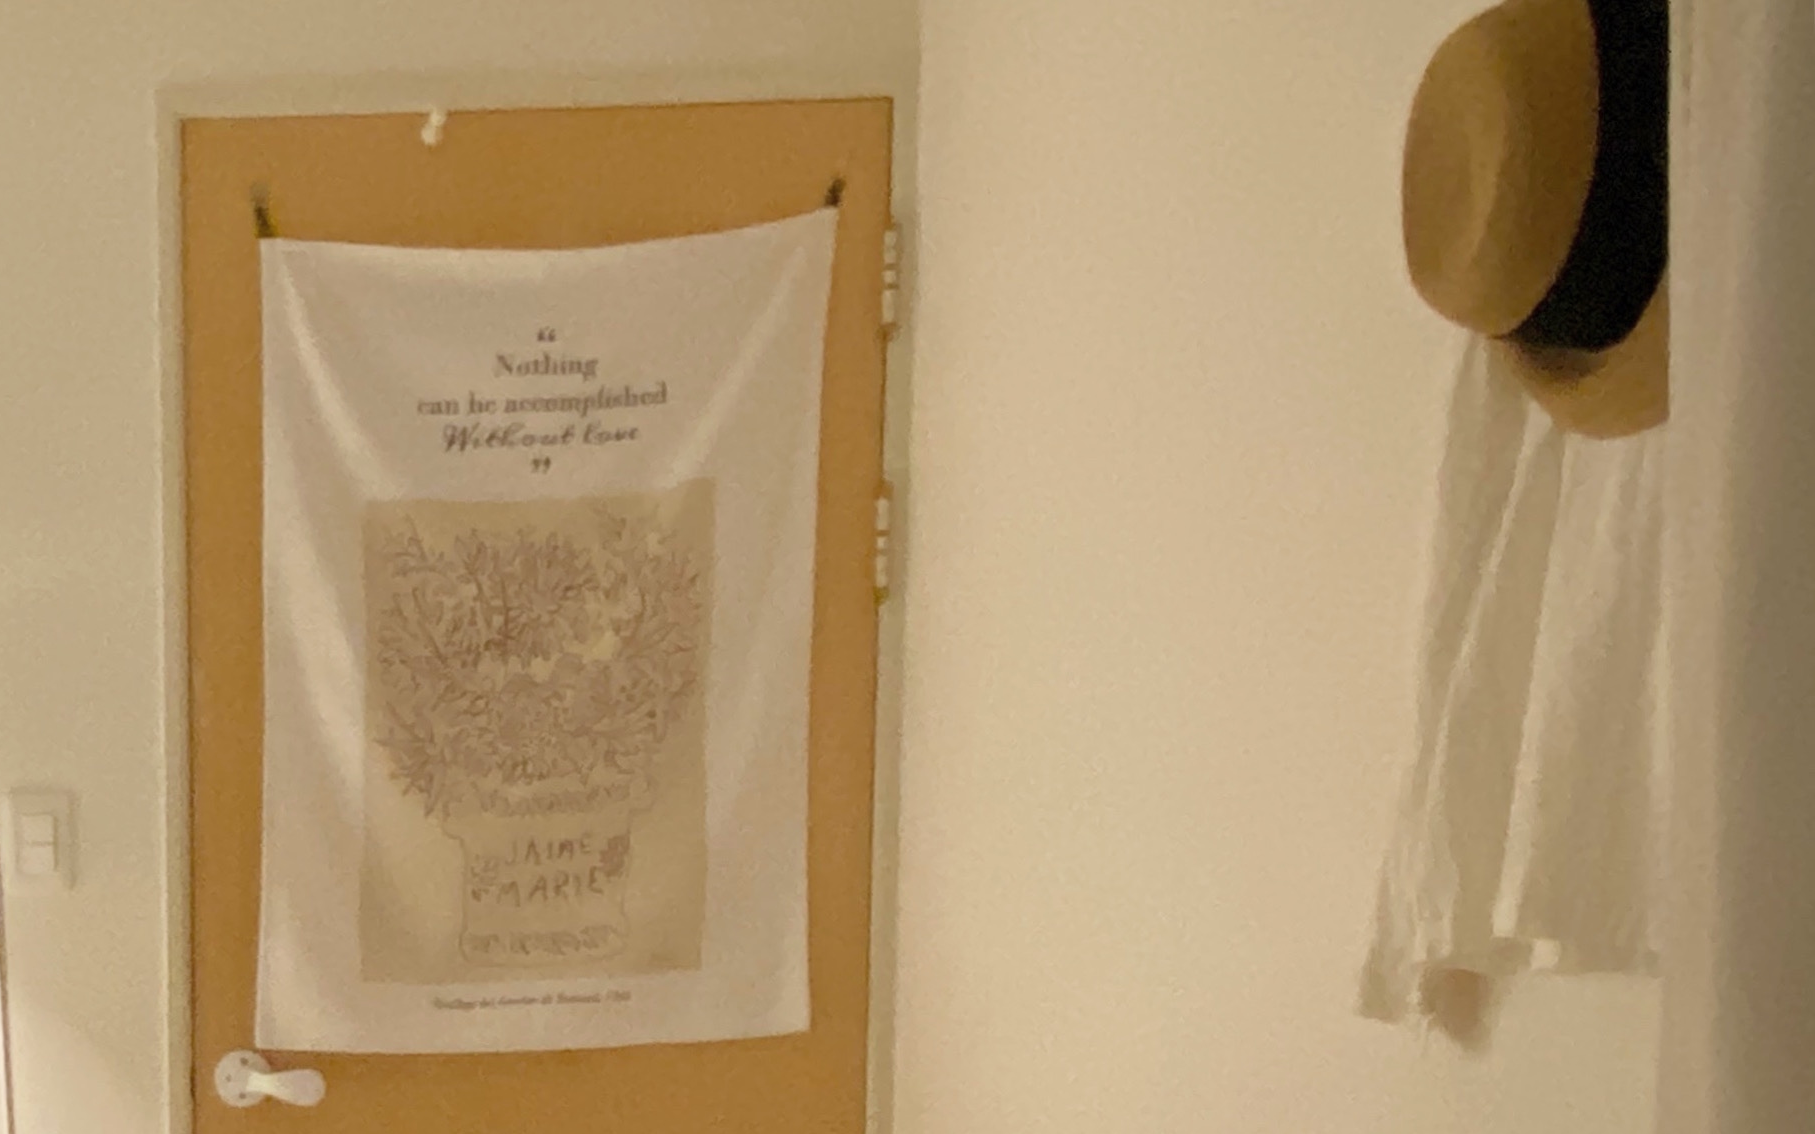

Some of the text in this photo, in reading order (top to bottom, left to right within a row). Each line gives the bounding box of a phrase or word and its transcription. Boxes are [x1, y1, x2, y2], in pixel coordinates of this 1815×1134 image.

[494, 352, 598, 381] Nothing
[417, 380, 668, 418] can be accomplished
[442, 421, 639, 453] Without love
[496, 866, 604, 907] MARIE
